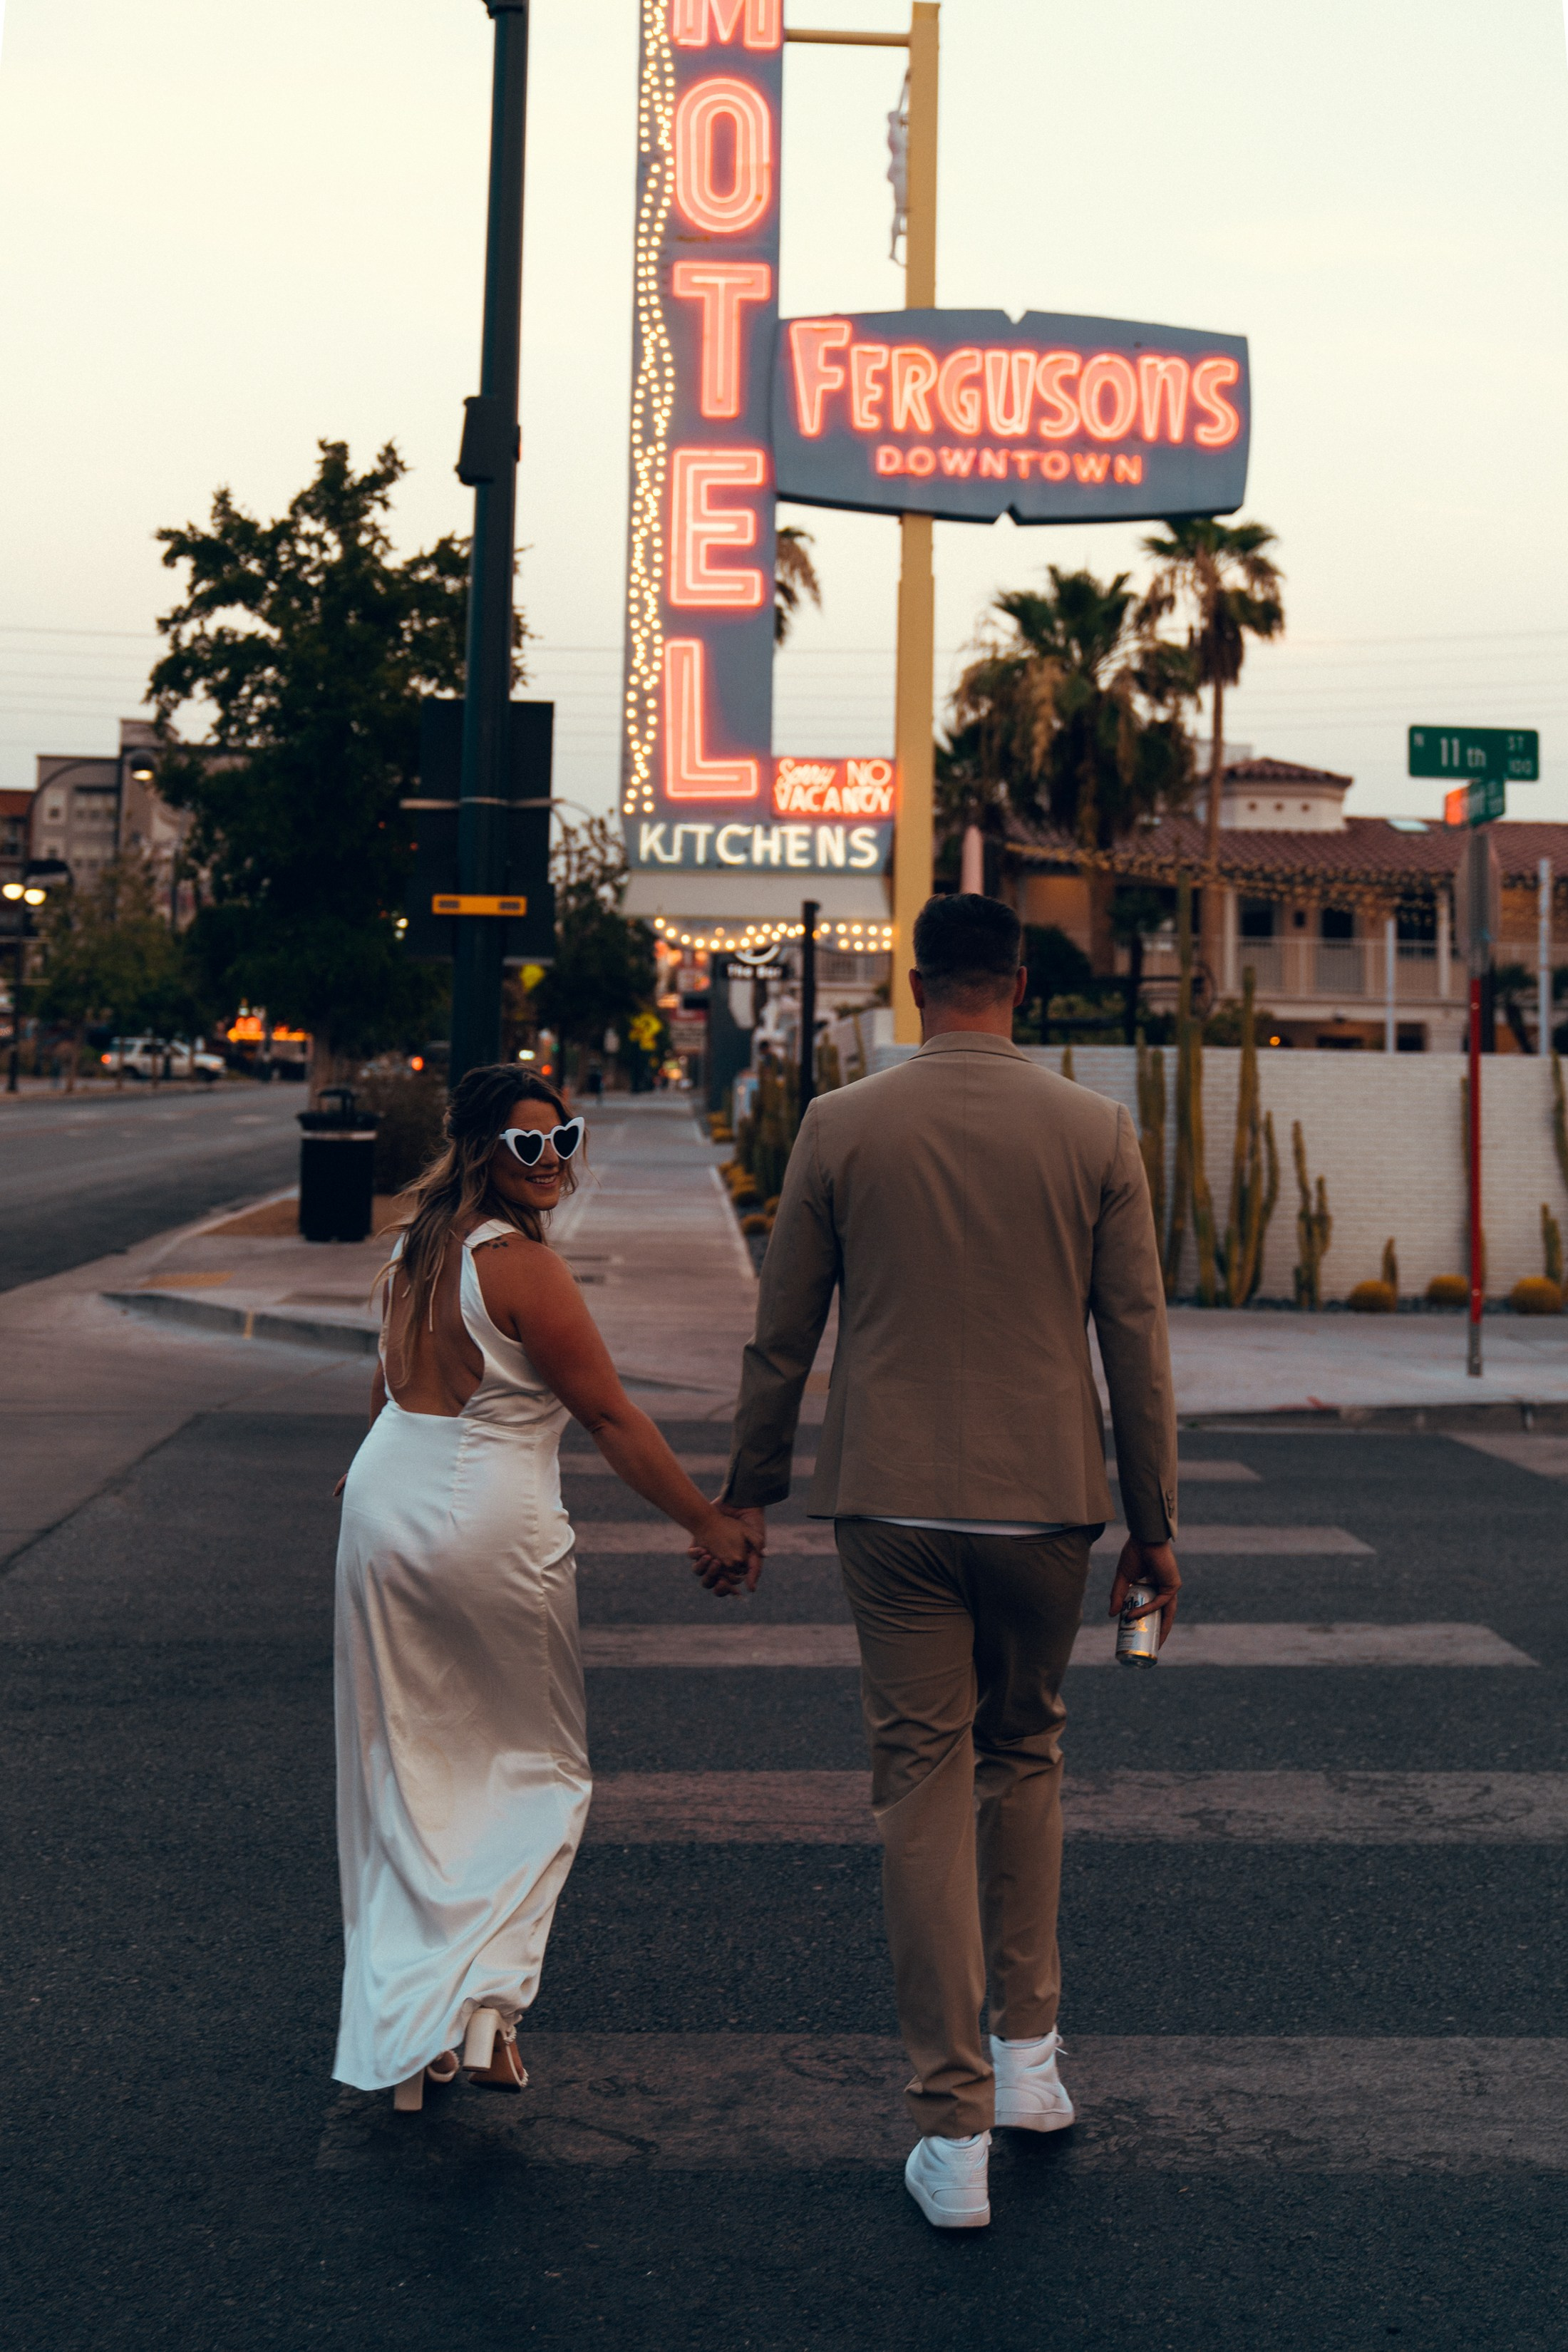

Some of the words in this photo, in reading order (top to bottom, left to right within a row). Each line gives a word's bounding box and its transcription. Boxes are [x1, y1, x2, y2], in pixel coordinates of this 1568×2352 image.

[788, 319, 1240, 448] FERGUSONS
[875, 445, 1143, 485] DOWNTOWN
[1507, 735, 1524, 751] ST
[847, 760, 892, 786] NO
[774, 785, 894, 814] VACANCY
[639, 822, 880, 868] KITCHENS
